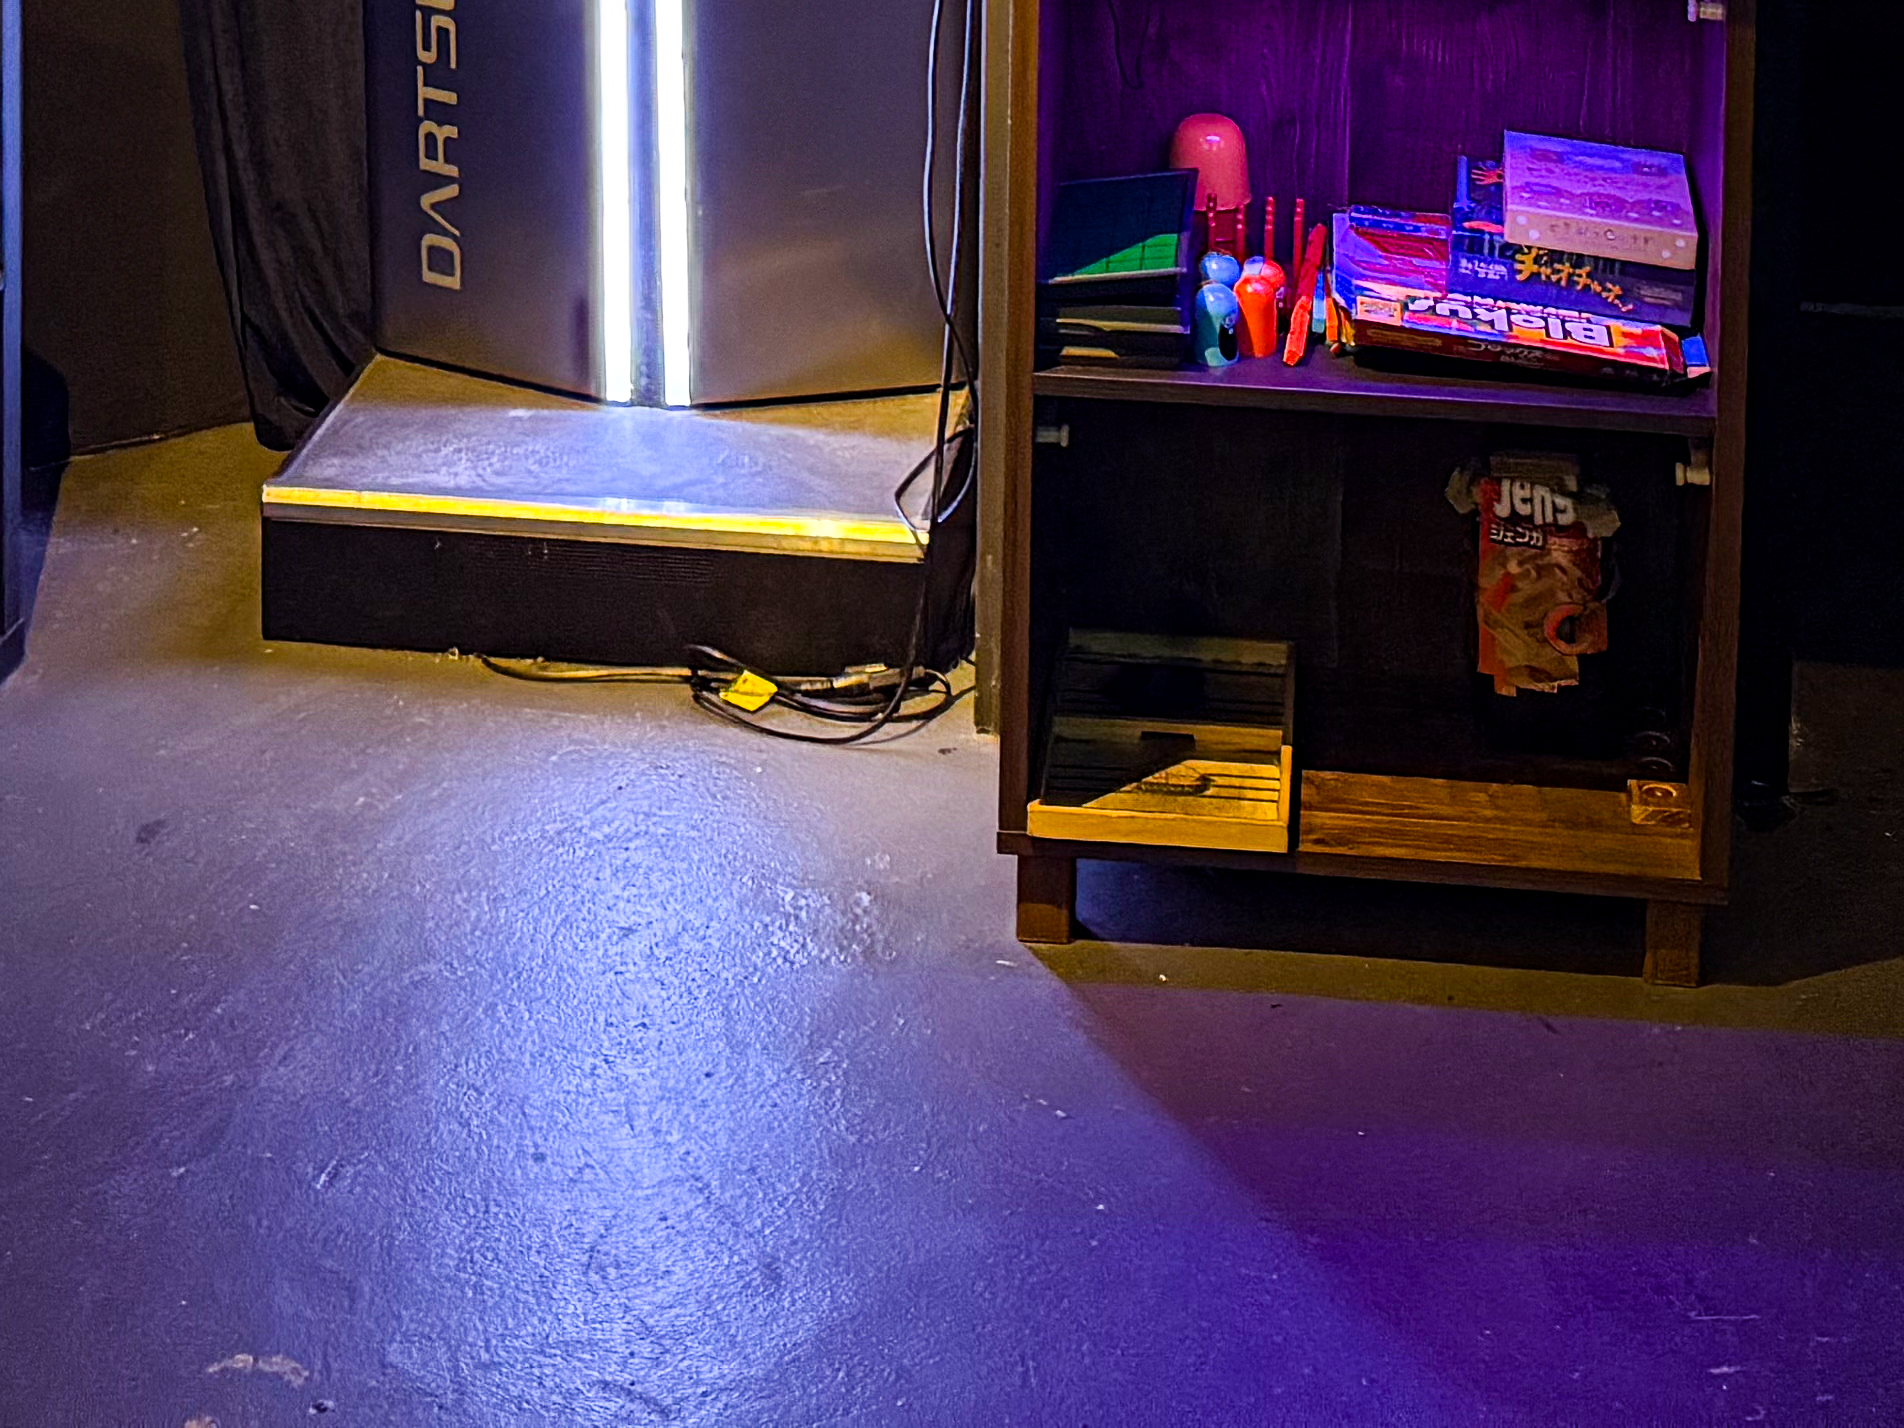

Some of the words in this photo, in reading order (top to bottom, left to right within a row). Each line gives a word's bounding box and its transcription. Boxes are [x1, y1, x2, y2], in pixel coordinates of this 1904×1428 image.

[1407, 296, 1612, 347] Blokus
[1489, 523, 1544, 547] ジェンガ
